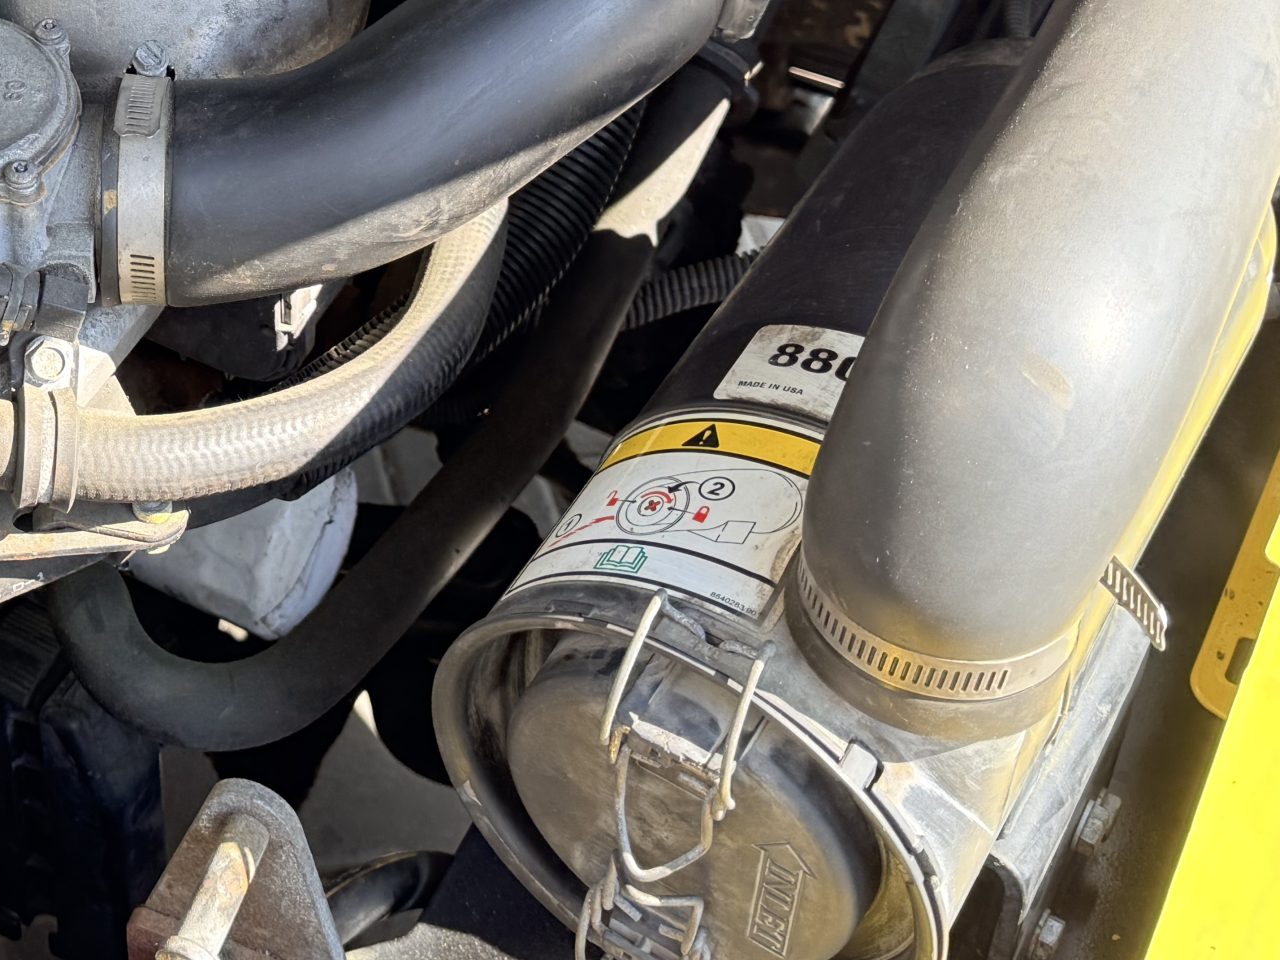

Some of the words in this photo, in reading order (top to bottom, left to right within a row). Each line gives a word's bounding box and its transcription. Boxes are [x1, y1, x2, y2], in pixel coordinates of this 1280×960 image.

[737, 380, 766, 389] MADE
[769, 382, 780, 390] IN
[783, 384, 804, 396] USA
[753, 857, 800, 953] INLET
